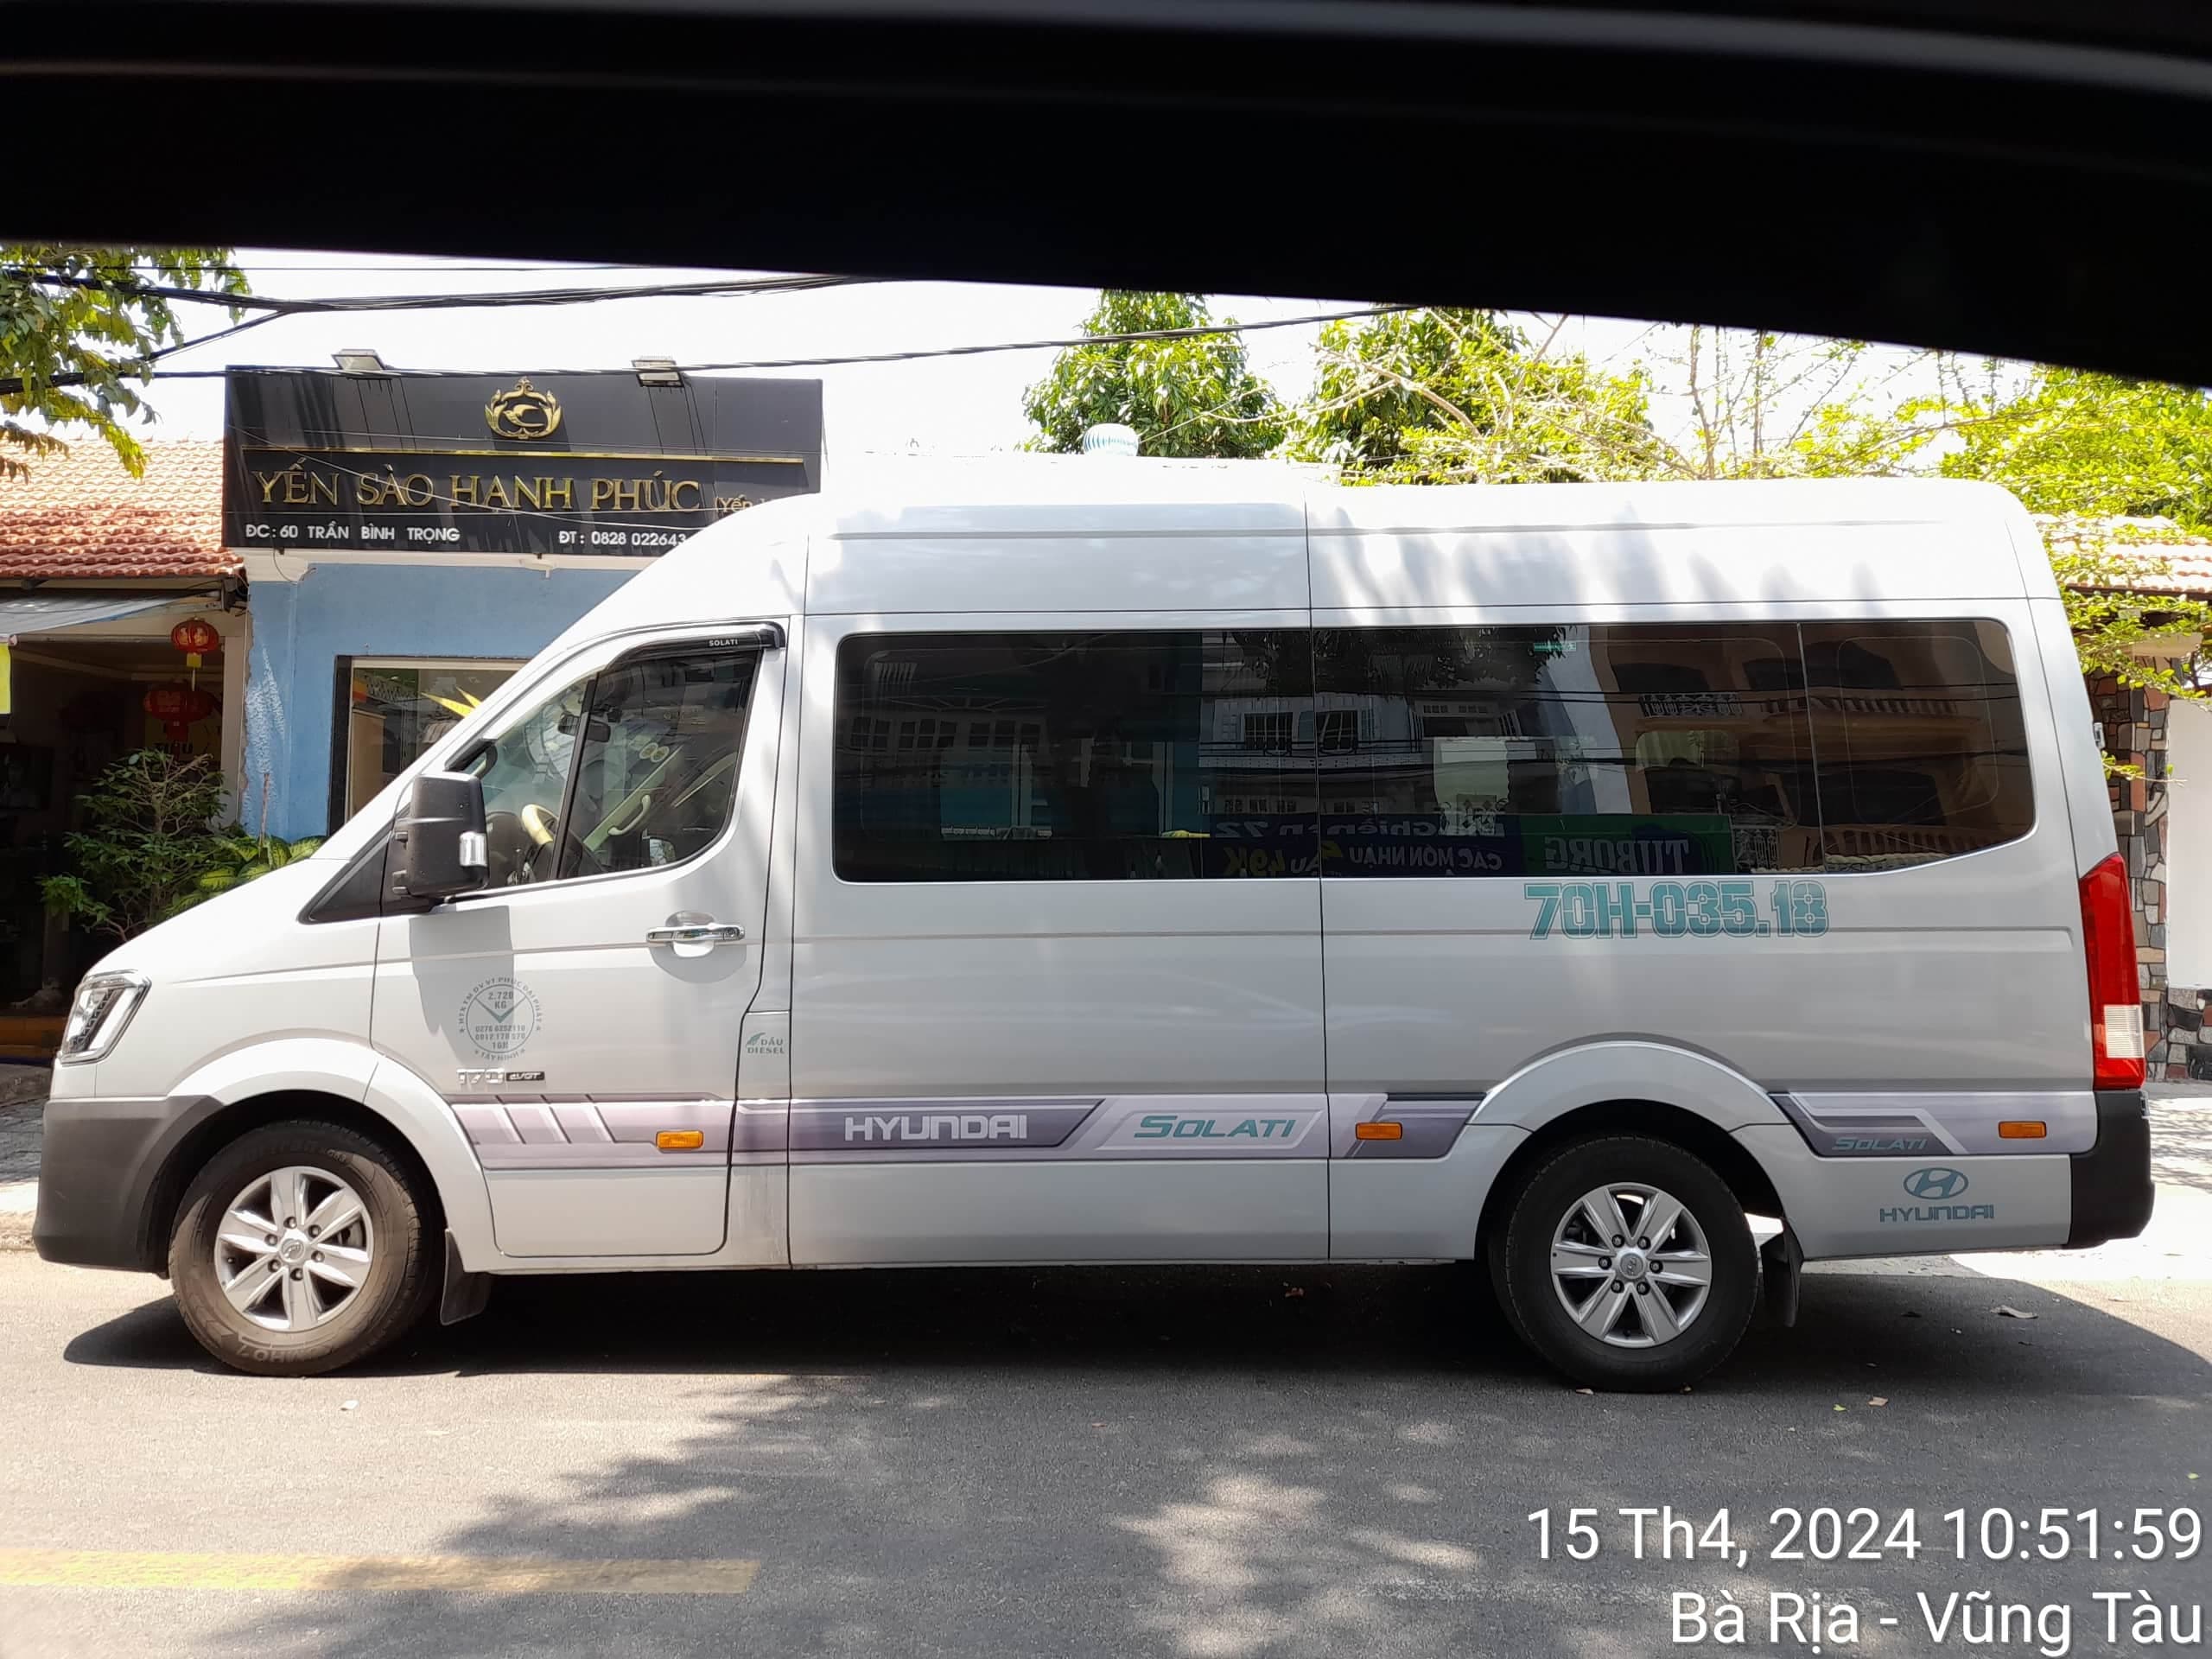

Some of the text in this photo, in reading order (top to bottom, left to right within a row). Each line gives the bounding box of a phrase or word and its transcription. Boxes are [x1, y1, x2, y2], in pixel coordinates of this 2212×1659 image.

[254, 457, 339, 505] YẾN
[356, 464, 434, 506] SÀO
[590, 470, 700, 512] PHÚC
[307, 521, 350, 539] TRẦN
[360, 522, 395, 540] BÌNH
[407, 527, 461, 544] TRỌNG
[591, 531, 626, 545] 0828
[709, 639, 739, 647] SOLATI
[1524, 880, 1830, 940] 70H-035.18
[494, 1001, 507, 1010] KG
[845, 1115, 1028, 1141] HYUNDAI
[1879, 1204, 1995, 1223] HYUNDAI
